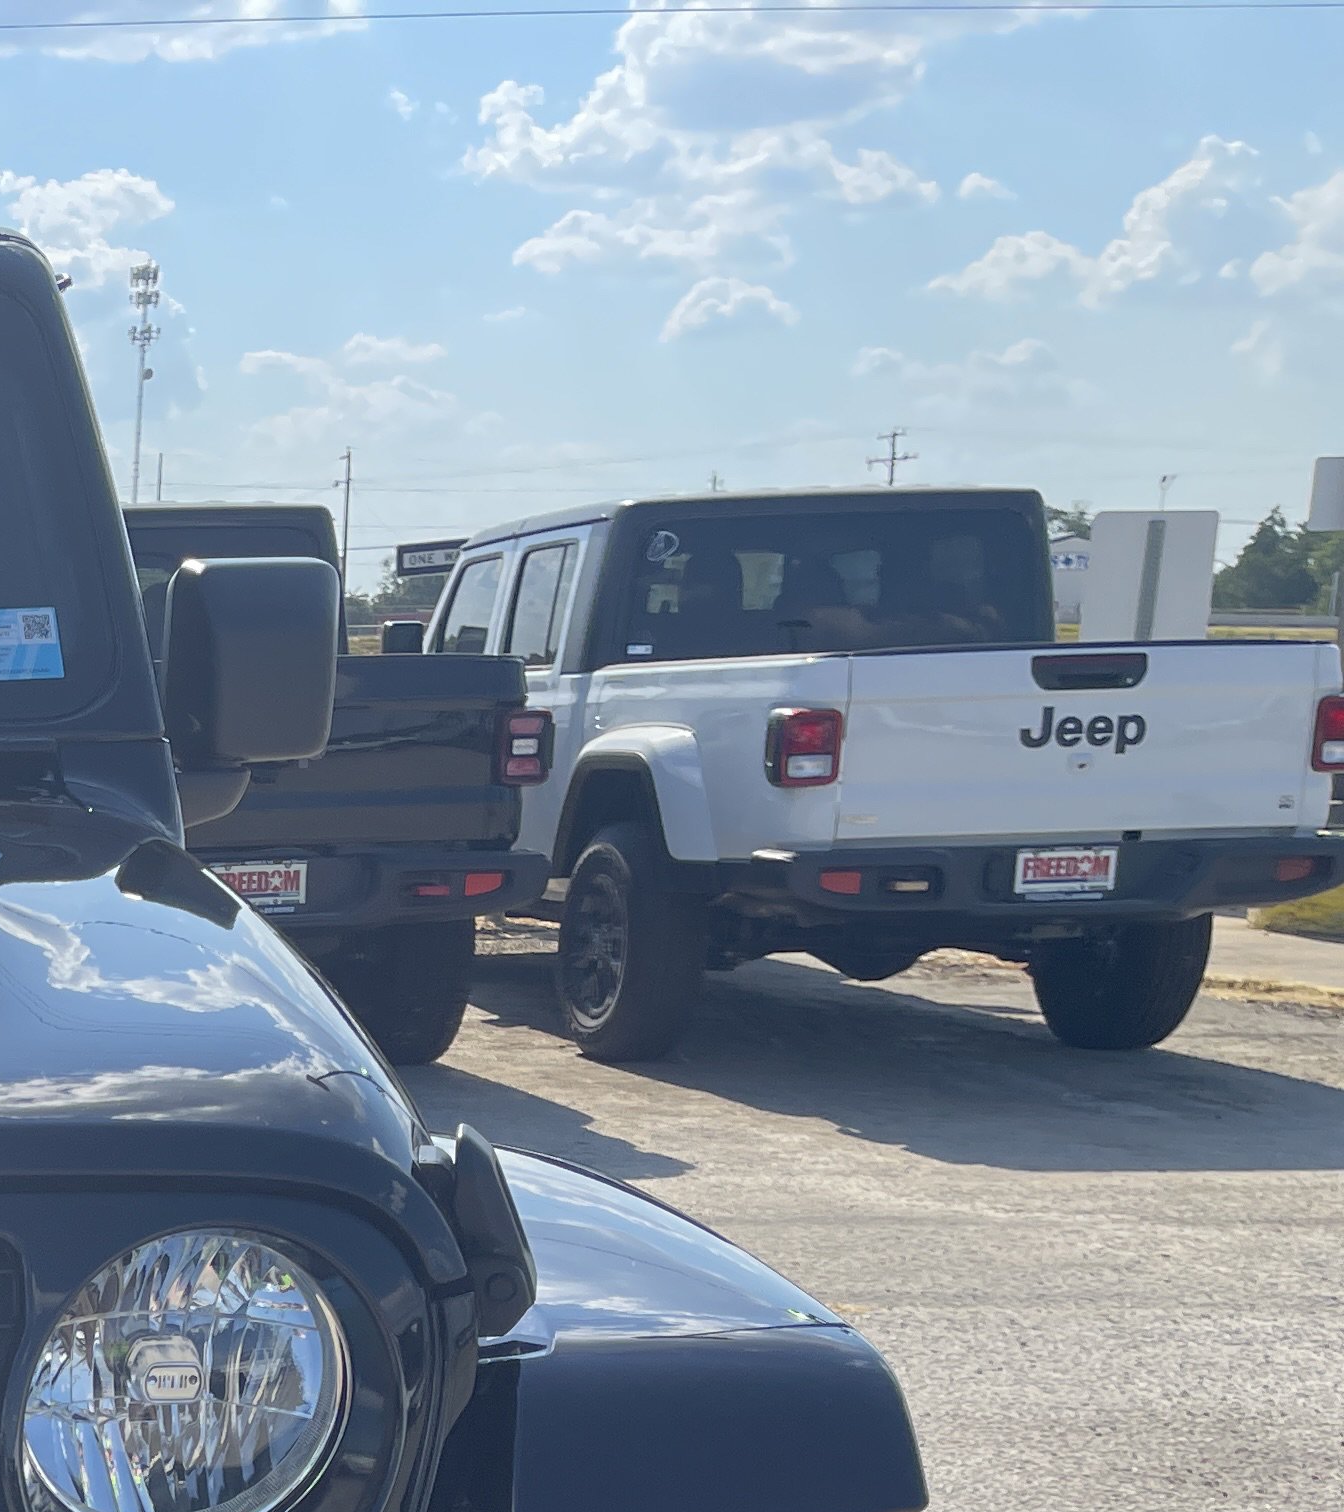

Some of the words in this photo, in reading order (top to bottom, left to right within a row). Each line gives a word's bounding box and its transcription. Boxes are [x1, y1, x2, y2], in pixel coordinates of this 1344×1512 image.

[409, 553, 435, 565] ONE
[1019, 706, 1146, 754] Jeep
[1023, 855, 1110, 879] FREEDOM
[216, 870, 300, 893] REEDOM
